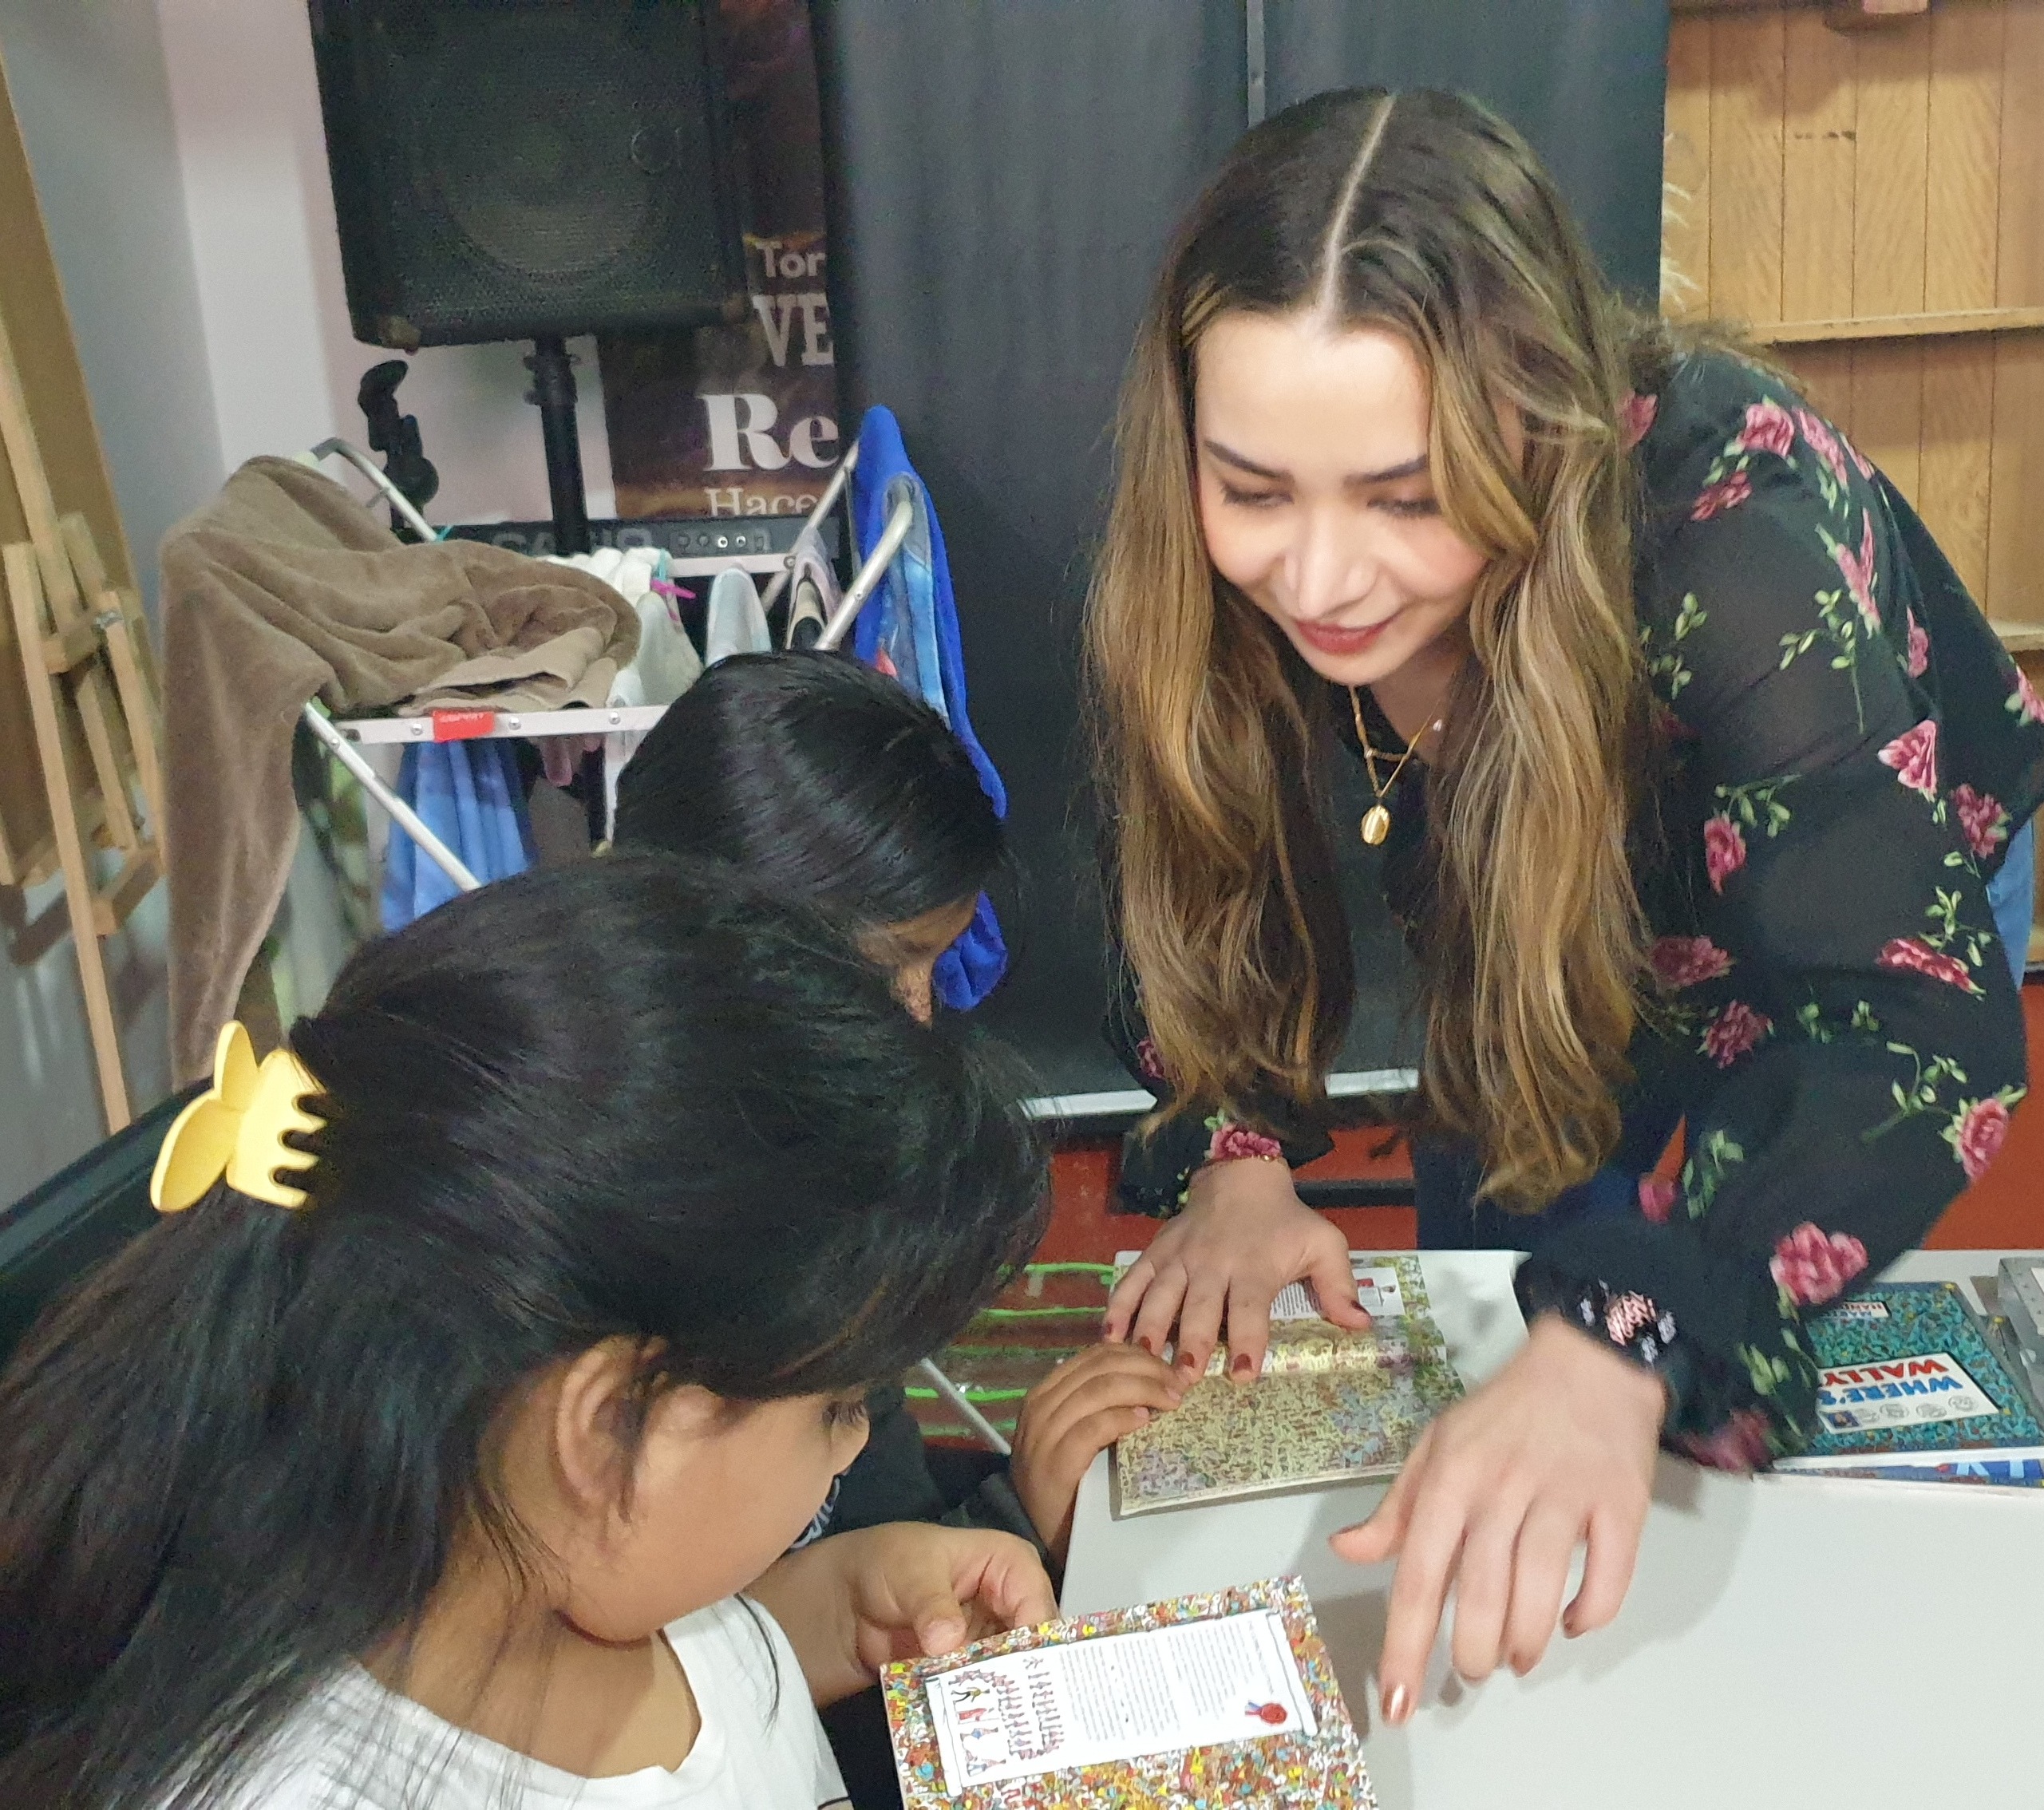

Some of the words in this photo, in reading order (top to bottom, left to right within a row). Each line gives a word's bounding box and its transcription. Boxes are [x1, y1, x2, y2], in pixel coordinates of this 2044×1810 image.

[700, 393, 839, 470] Re
[1824, 1359, 1949, 1386] WALLY
[1817, 1376, 1963, 1405] WHERE'S
